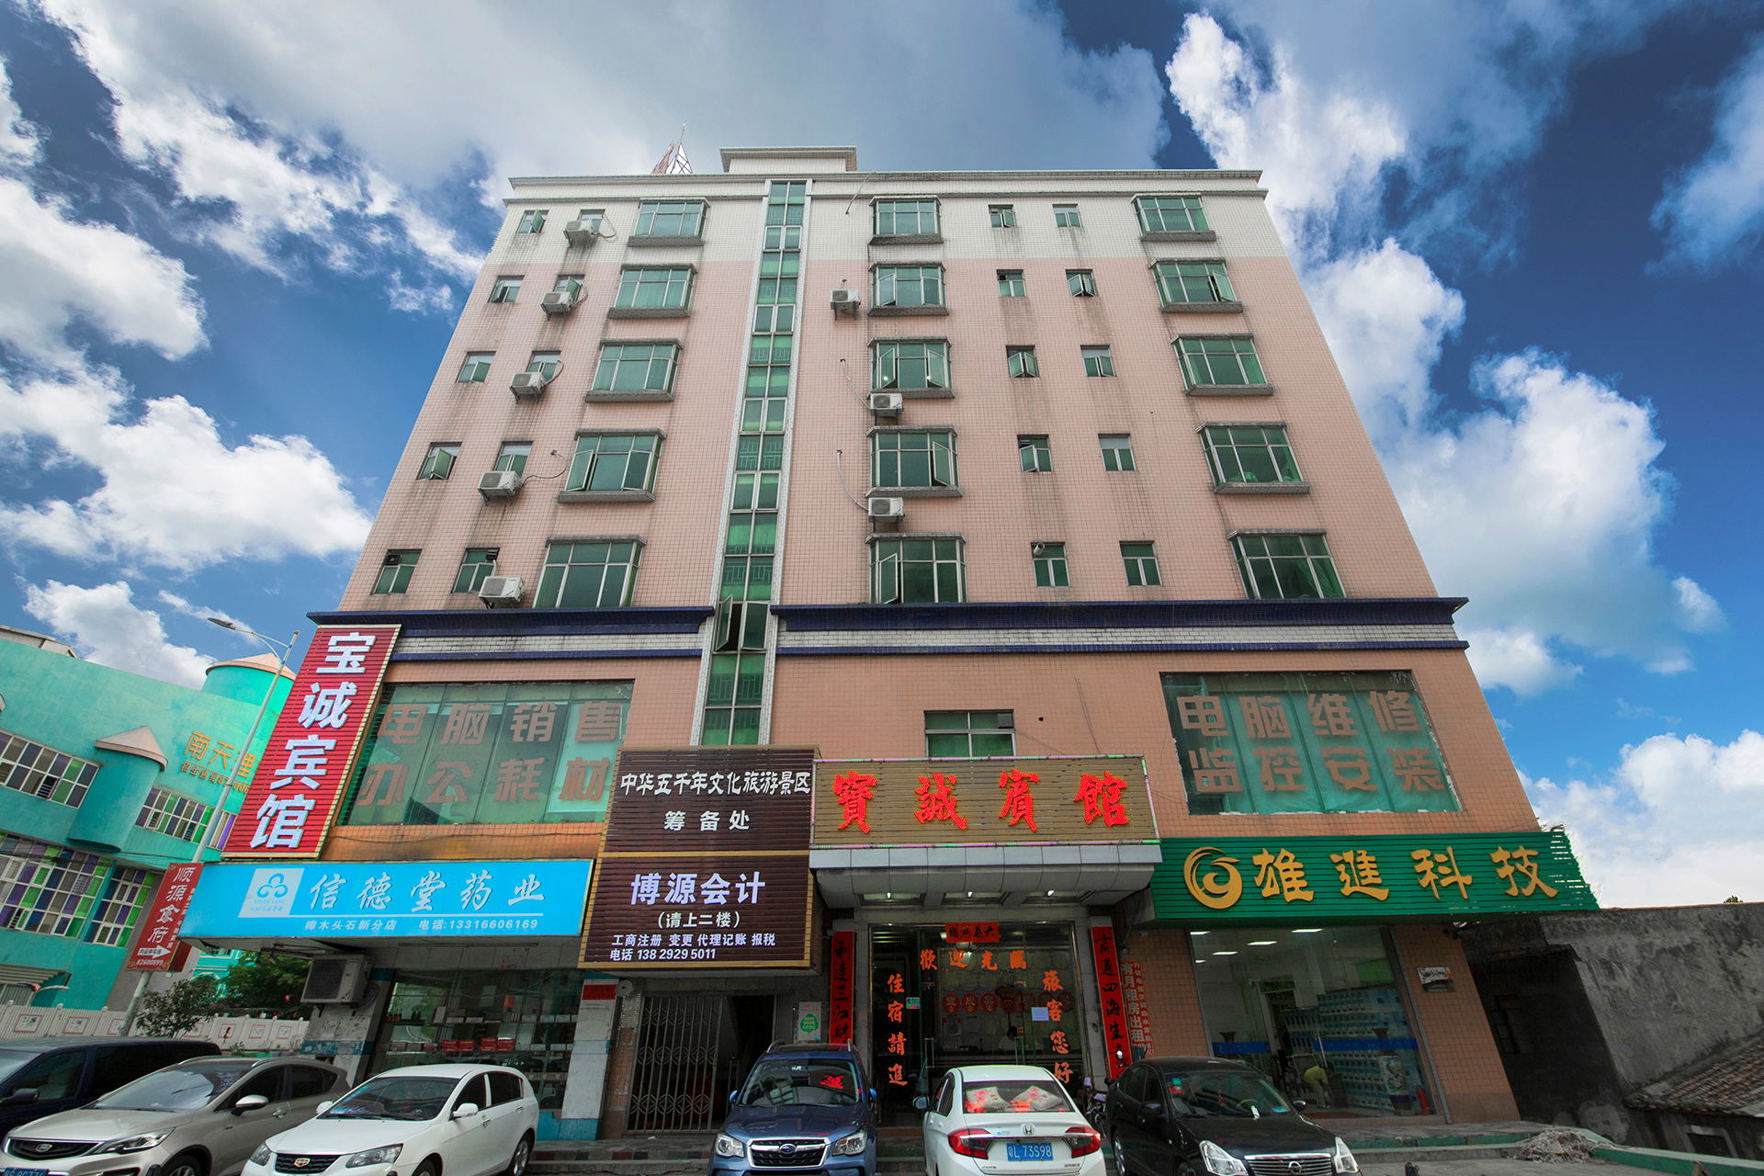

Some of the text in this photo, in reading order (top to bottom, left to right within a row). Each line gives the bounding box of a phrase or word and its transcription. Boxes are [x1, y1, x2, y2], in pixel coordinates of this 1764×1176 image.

[377, 701, 623, 745] 电脑销售
[1175, 690, 1422, 739] 电脑维修
[249, 632, 376, 849] 宝诚宾馆
[354, 757, 611, 806] 办公耗材
[620, 771, 811, 796] 中华五千年文化旅游景区
[1188, 745, 1446, 793] 监控安装
[664, 810, 750, 831] 筹备处
[833, 769, 1129, 834] 寶誠賓館
[147, 866, 197, 943] 顺源食府
[309, 870, 545, 913] 信德堂药业
[630, 871, 766, 905] 博源会计
[611, 934, 663, 947] 工商注册
[669, 934, 694, 946] 变更
[751, 933, 776, 946] 报税
[658, 911, 741, 929] （请上二楼）
[609, 948, 716, 961] 电话 138 2929 5011
[887, 973, 908, 1087] 住宿請進
